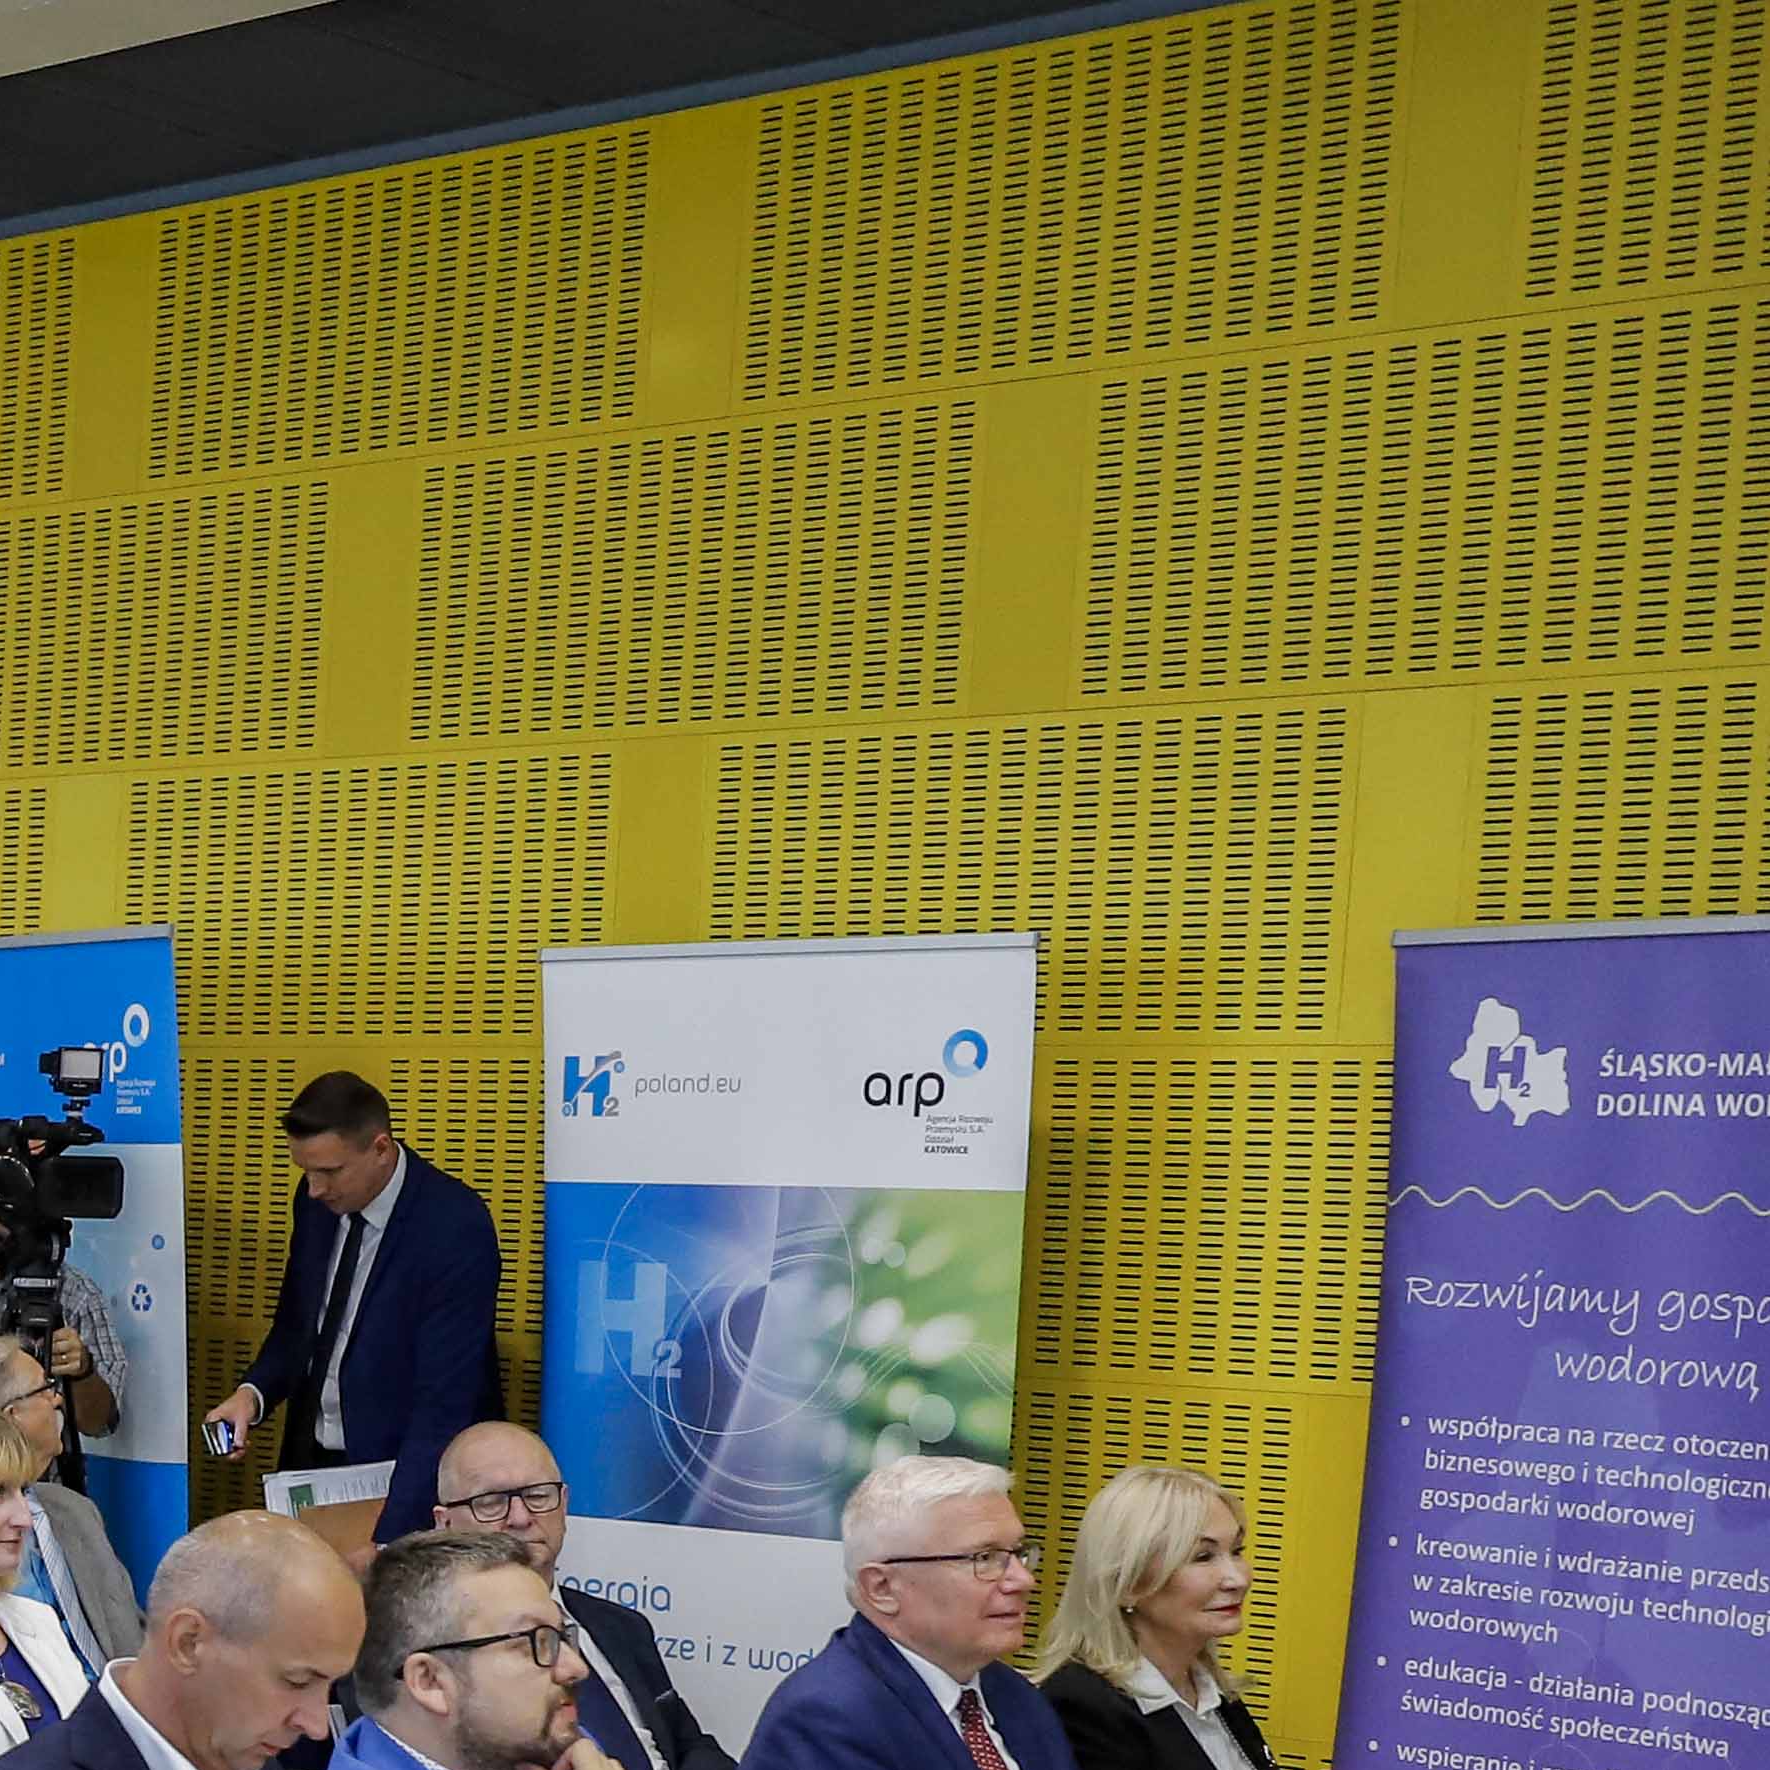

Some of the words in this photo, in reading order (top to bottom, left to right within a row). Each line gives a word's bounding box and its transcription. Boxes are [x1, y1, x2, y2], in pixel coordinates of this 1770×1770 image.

[635, 1073, 741, 1099] poland.eu
[863, 1072, 945, 1118] arp
[1596, 1093, 1706, 1117] DOLINA
[1716, 1093, 1770, 1118] WO
[924, 1145, 969, 1155] KATOWICE
[575, 1260, 683, 1379] H2
[1405, 1269, 1640, 1336] Rozwijamy
[1555, 1344, 1760, 1403] wodorową
[1428, 1416, 1560, 1445] współpraca
[1567, 1428, 1595, 1446] na
[1603, 1430, 1665, 1452] rzecz
[1424, 1448, 1575, 1485] biznesowego
[1582, 1462, 1589, 1484] i
[1596, 1464, 1770, 1500] technologiczn
[1420, 1488, 1550, 1517] gospodarki
[1556, 1499, 1696, 1536] wodorowej
[1416, 1533, 1538, 1568] kreowanie
[1544, 1548, 1552, 1569] i
[1557, 1551, 1683, 1583] wdrażanie
[1690, 1567, 1770, 1593] przeds
[555, 1567, 671, 1612] nergia
[1413, 1574, 1433, 1592] w
[1439, 1574, 1533, 1604] zakresie
[1540, 1588, 1635, 1618] rozwoju
[1410, 1608, 1559, 1644] wodorowych
[722, 1644, 738, 1667] z
[1404, 1656, 1507, 1690] edukacja
[1529, 1672, 1634, 1706] działania
[1400, 1689, 1544, 1731] świadomość
[1549, 1714, 1729, 1759] społeczeństwa
